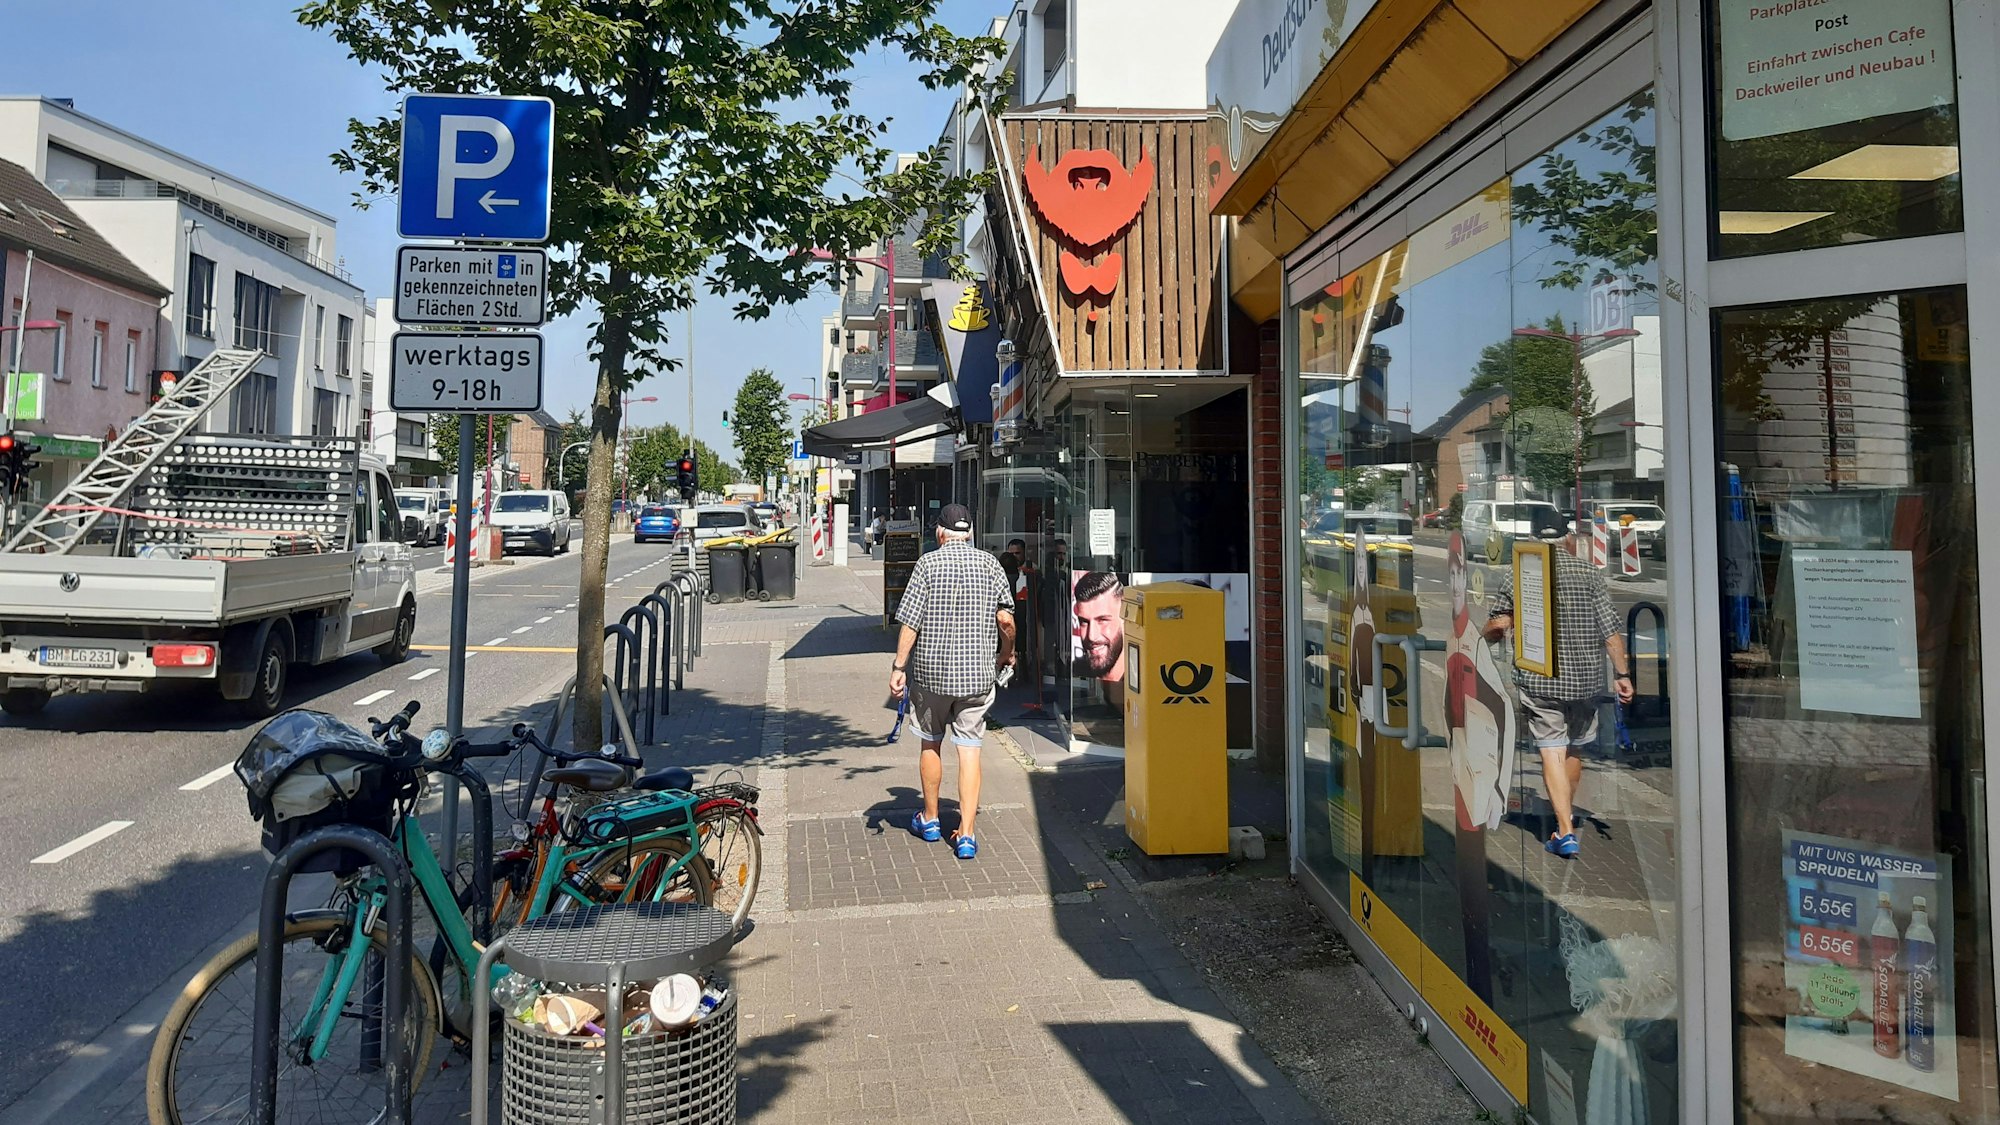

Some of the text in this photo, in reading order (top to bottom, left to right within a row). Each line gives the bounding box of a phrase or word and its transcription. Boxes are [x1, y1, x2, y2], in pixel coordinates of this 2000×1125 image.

[1815, 14, 1849, 32] Post
[1748, 26, 1926, 74] Einfahrt zwischen Cafe
[1736, 75, 1820, 101] Dackweiler
[1825, 65, 1855, 83] und
[1860, 54, 1925, 76] Neubau
[436, 114, 516, 220] P
[1449, 212, 1482, 246] DHL
[410, 255, 534, 276] Parken mit in
[404, 277, 537, 297] gekennzeichneten
[417, 299, 522, 318] Flächen 2 Std.
[404, 344, 531, 372] werktags
[48, 648, 63, 661] BM
[89, 651, 111, 663] 231
[1798, 844, 1923, 876] MIT UNS WASSER
[1798, 860, 1876, 884] SPRUDELN
[1802, 895, 1854, 919] 5,55€
[1802, 932, 1854, 956] 6,55€
[1822, 972, 1844, 984] Jede
[1820, 995, 1844, 1008] gratis
[1824, 984, 1856, 1000] Füllung
[1878, 966, 1889, 1031] SODABLUE
[1914, 972, 1924, 1037] SODABLUE
[1465, 1004, 1499, 1057] DHL
